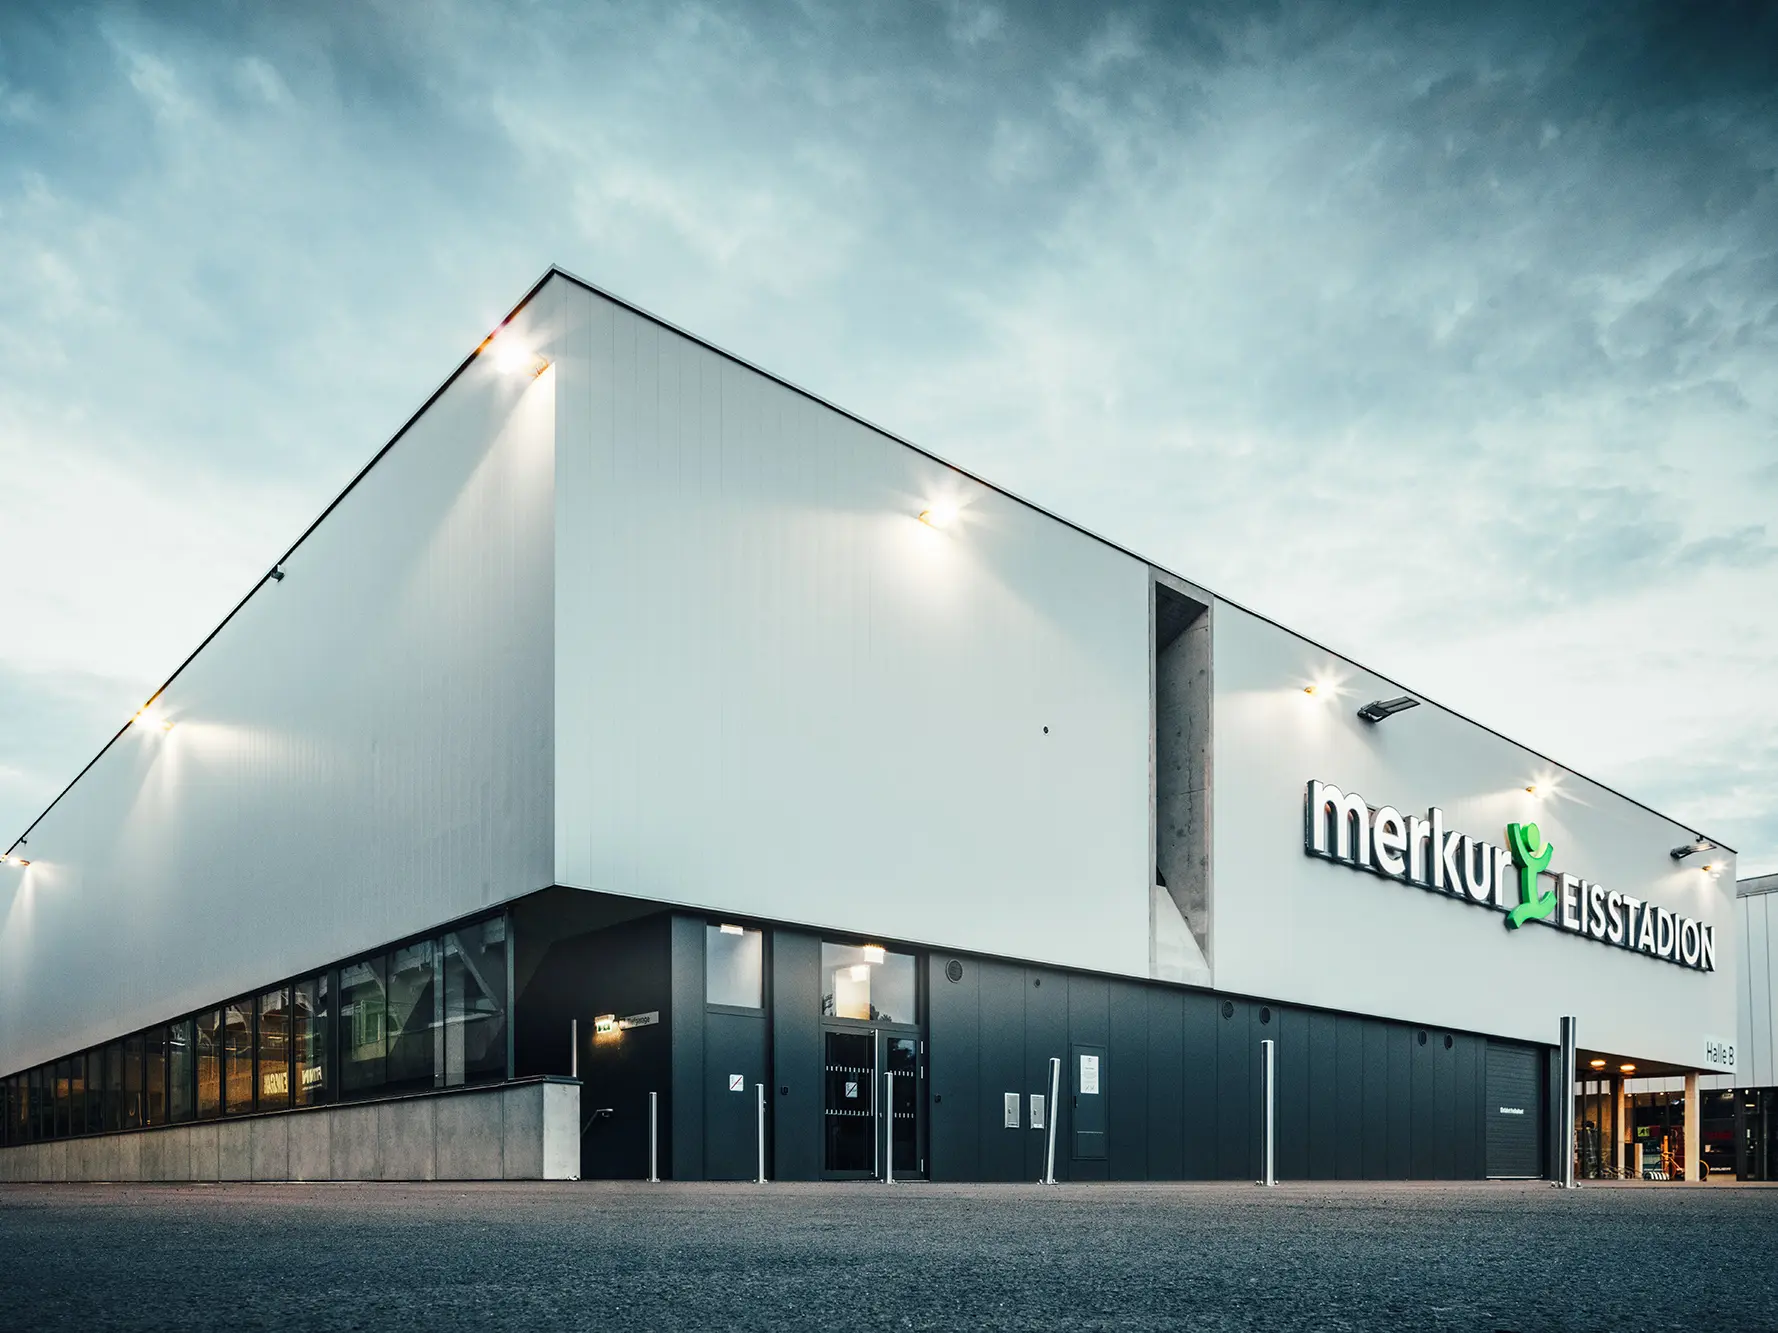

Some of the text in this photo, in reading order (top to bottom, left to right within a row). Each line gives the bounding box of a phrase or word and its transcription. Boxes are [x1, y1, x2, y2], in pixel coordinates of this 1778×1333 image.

[1306, 779, 1716, 972] merkur EISSTADION
[1706, 1041, 1735, 1065] Halle B
